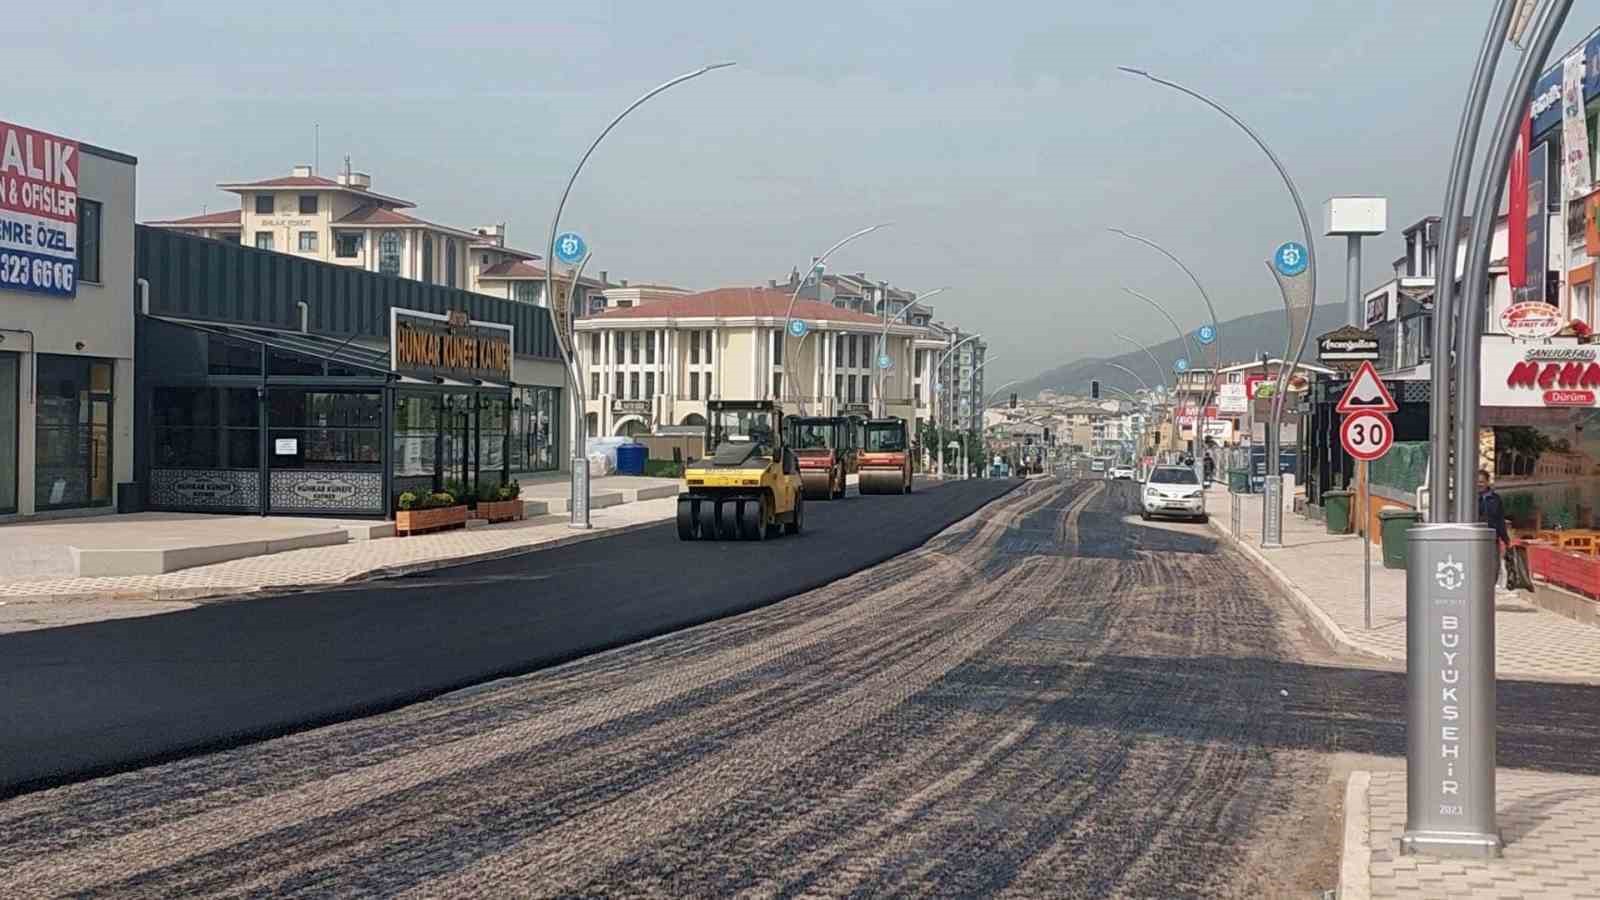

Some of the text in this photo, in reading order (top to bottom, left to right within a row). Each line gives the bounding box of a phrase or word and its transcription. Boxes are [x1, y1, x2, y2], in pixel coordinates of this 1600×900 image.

[37, 221, 75, 253] ÖZEL
[1551, 391, 1587, 402] Dürüm
[1351, 423, 1384, 446] 30
